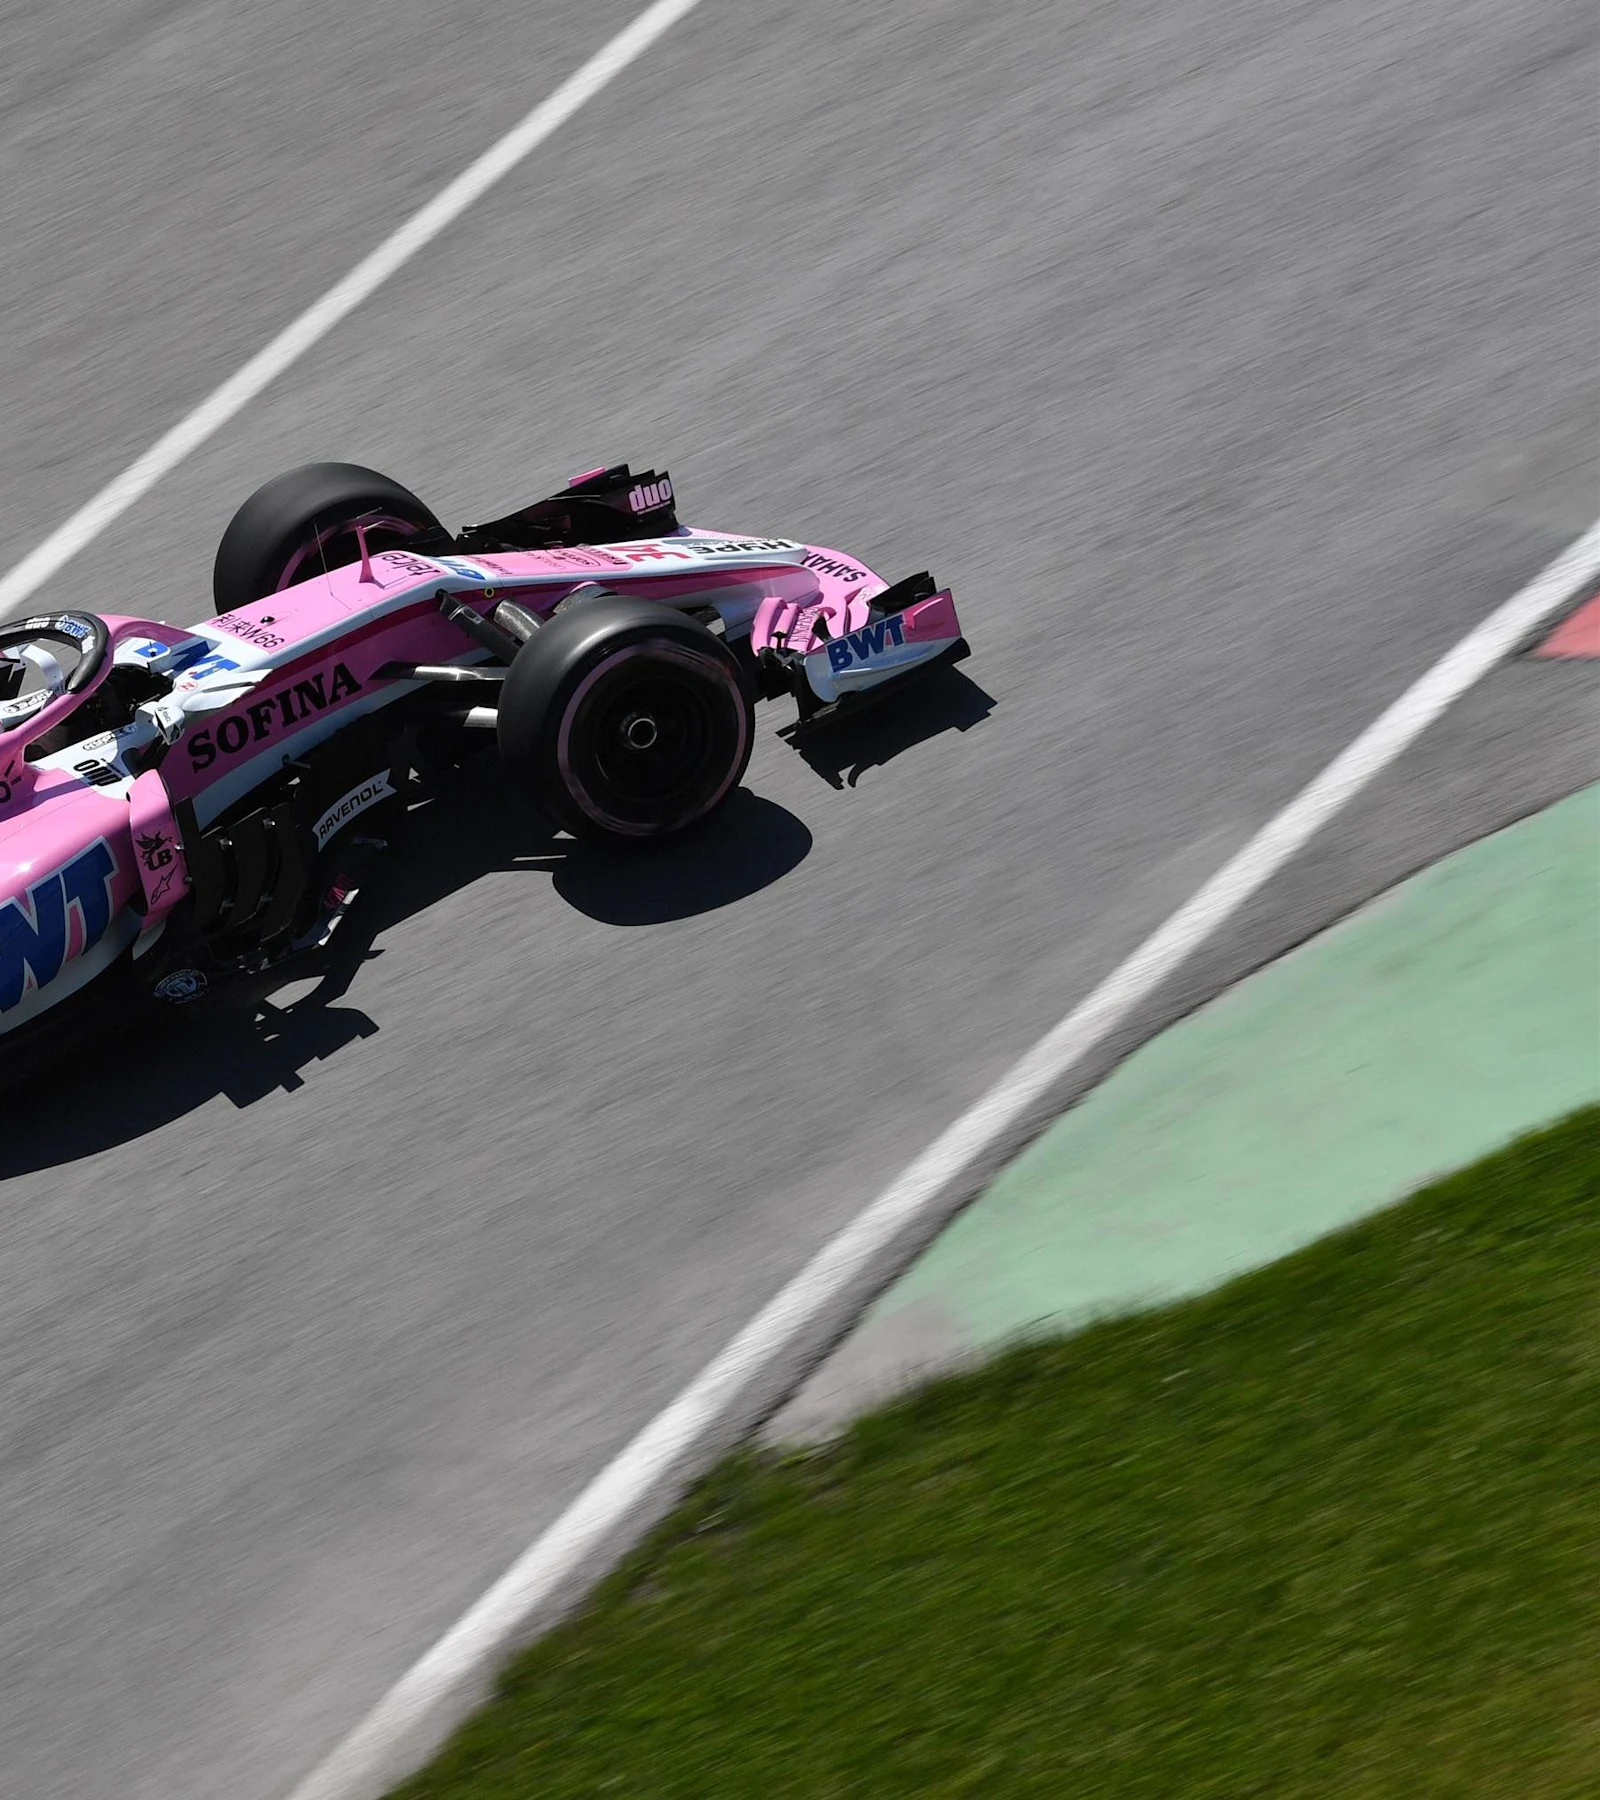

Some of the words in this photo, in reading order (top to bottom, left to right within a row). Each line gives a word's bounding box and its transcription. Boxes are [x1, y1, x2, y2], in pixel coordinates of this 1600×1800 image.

[628, 479, 672, 512] duo
[689, 540, 793, 555] HYPE
[826, 614, 905, 672] BWT
[187, 661, 363, 775] SOFINA
[318, 782, 385, 842] RAVENOL
